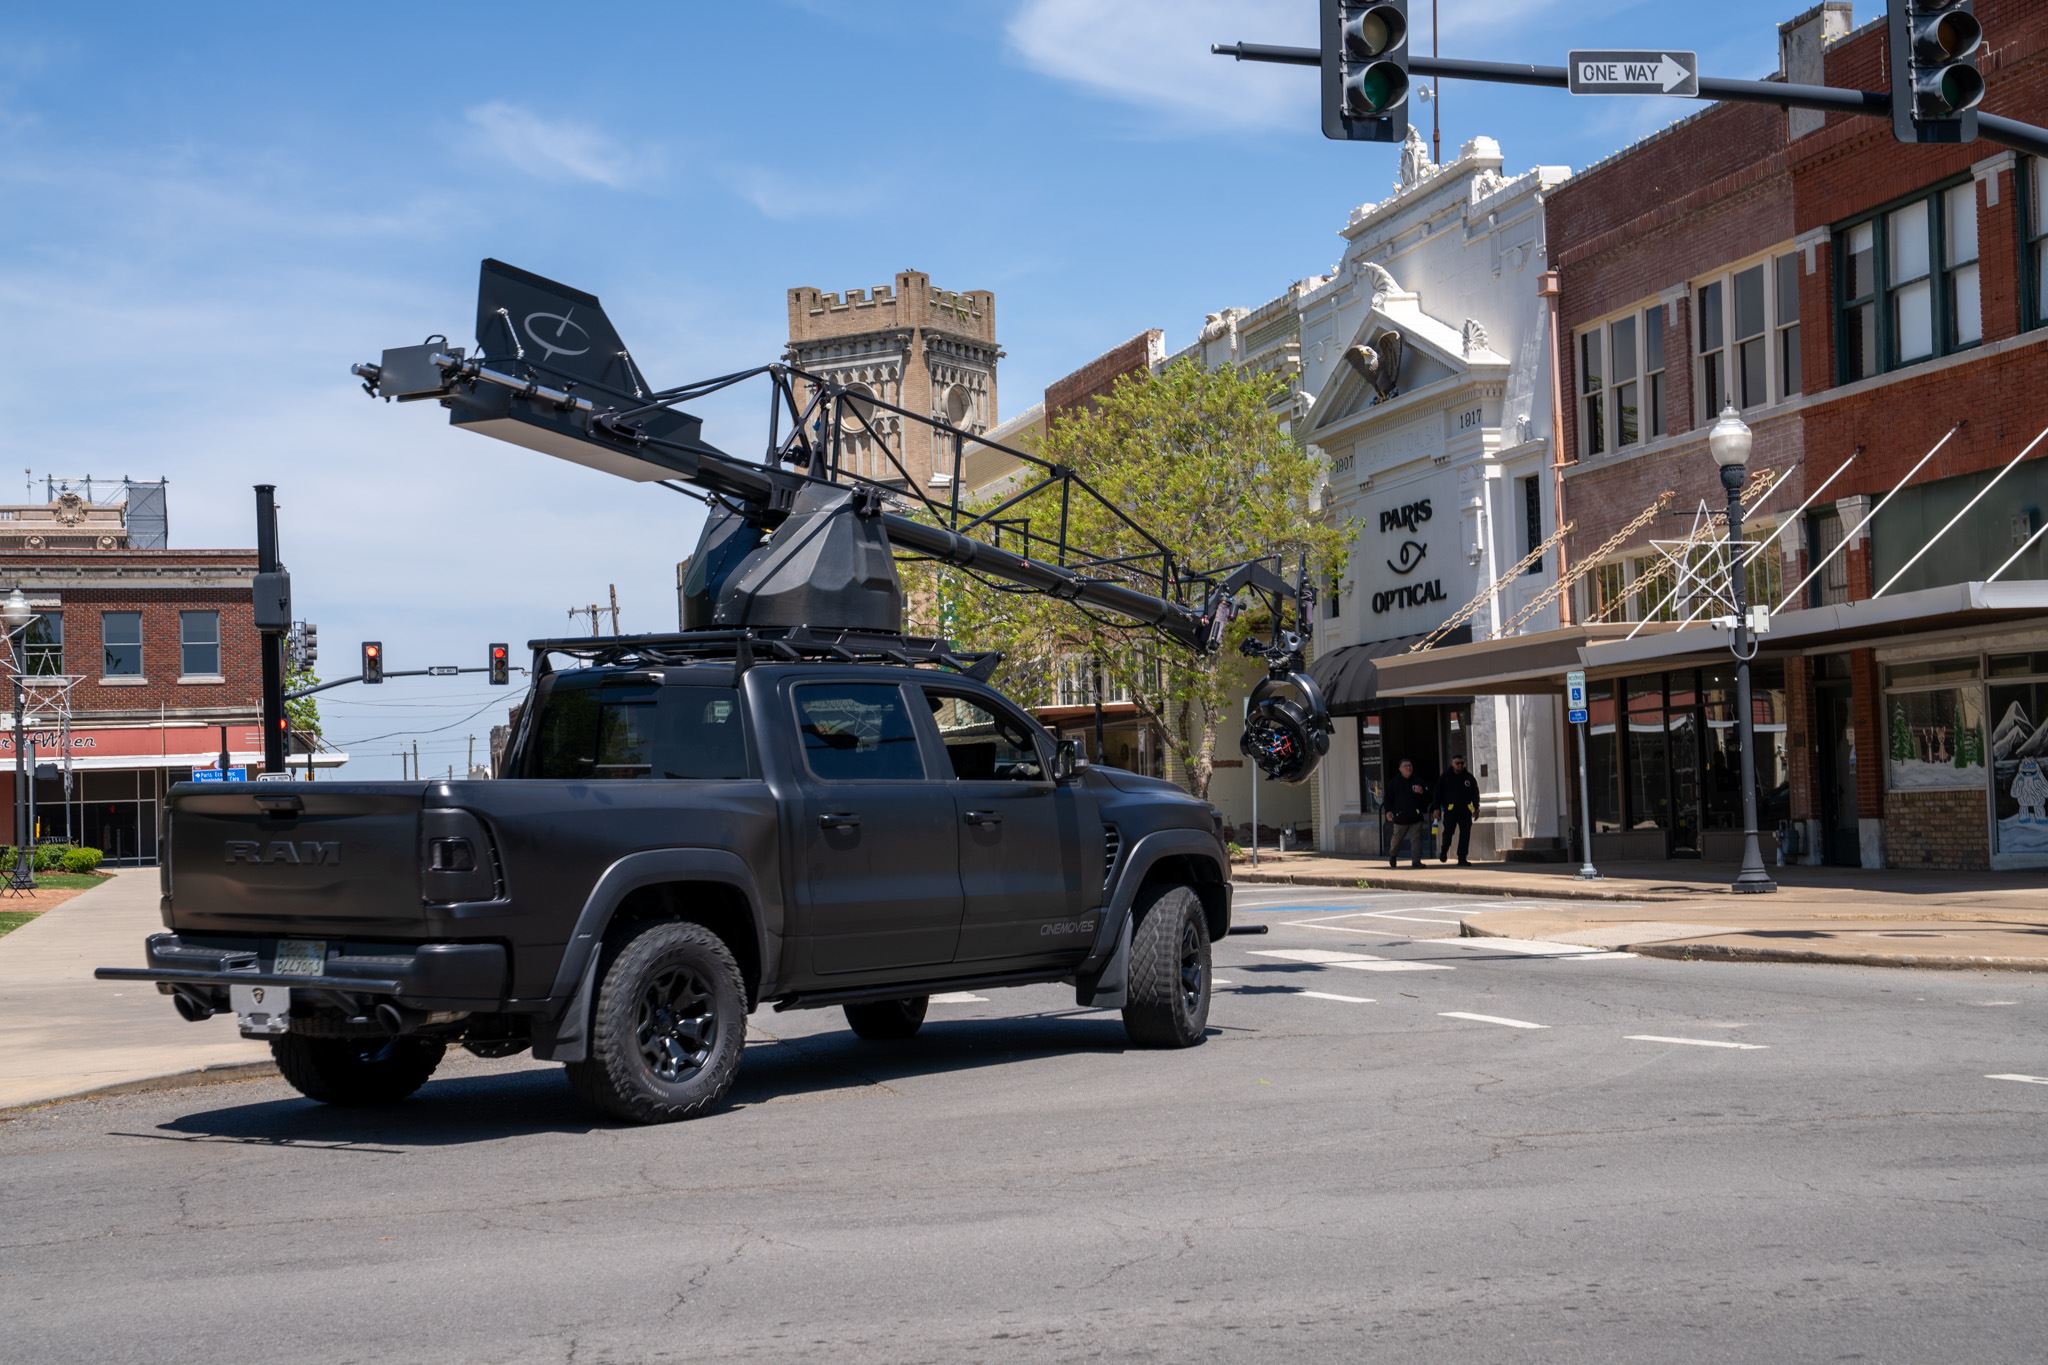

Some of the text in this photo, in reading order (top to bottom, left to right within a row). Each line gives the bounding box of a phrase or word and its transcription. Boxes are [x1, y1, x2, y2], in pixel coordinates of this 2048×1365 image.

[1583, 62, 1659, 82] ONE WAY
[1460, 409, 1482, 429] 1917
[1336, 455, 1354, 474] 1907
[1380, 499, 1432, 533] PARIS
[1372, 580, 1447, 615] OPTICAL
[225, 840, 341, 866] RAM
[1040, 921, 1095, 936] CINEMOVES
